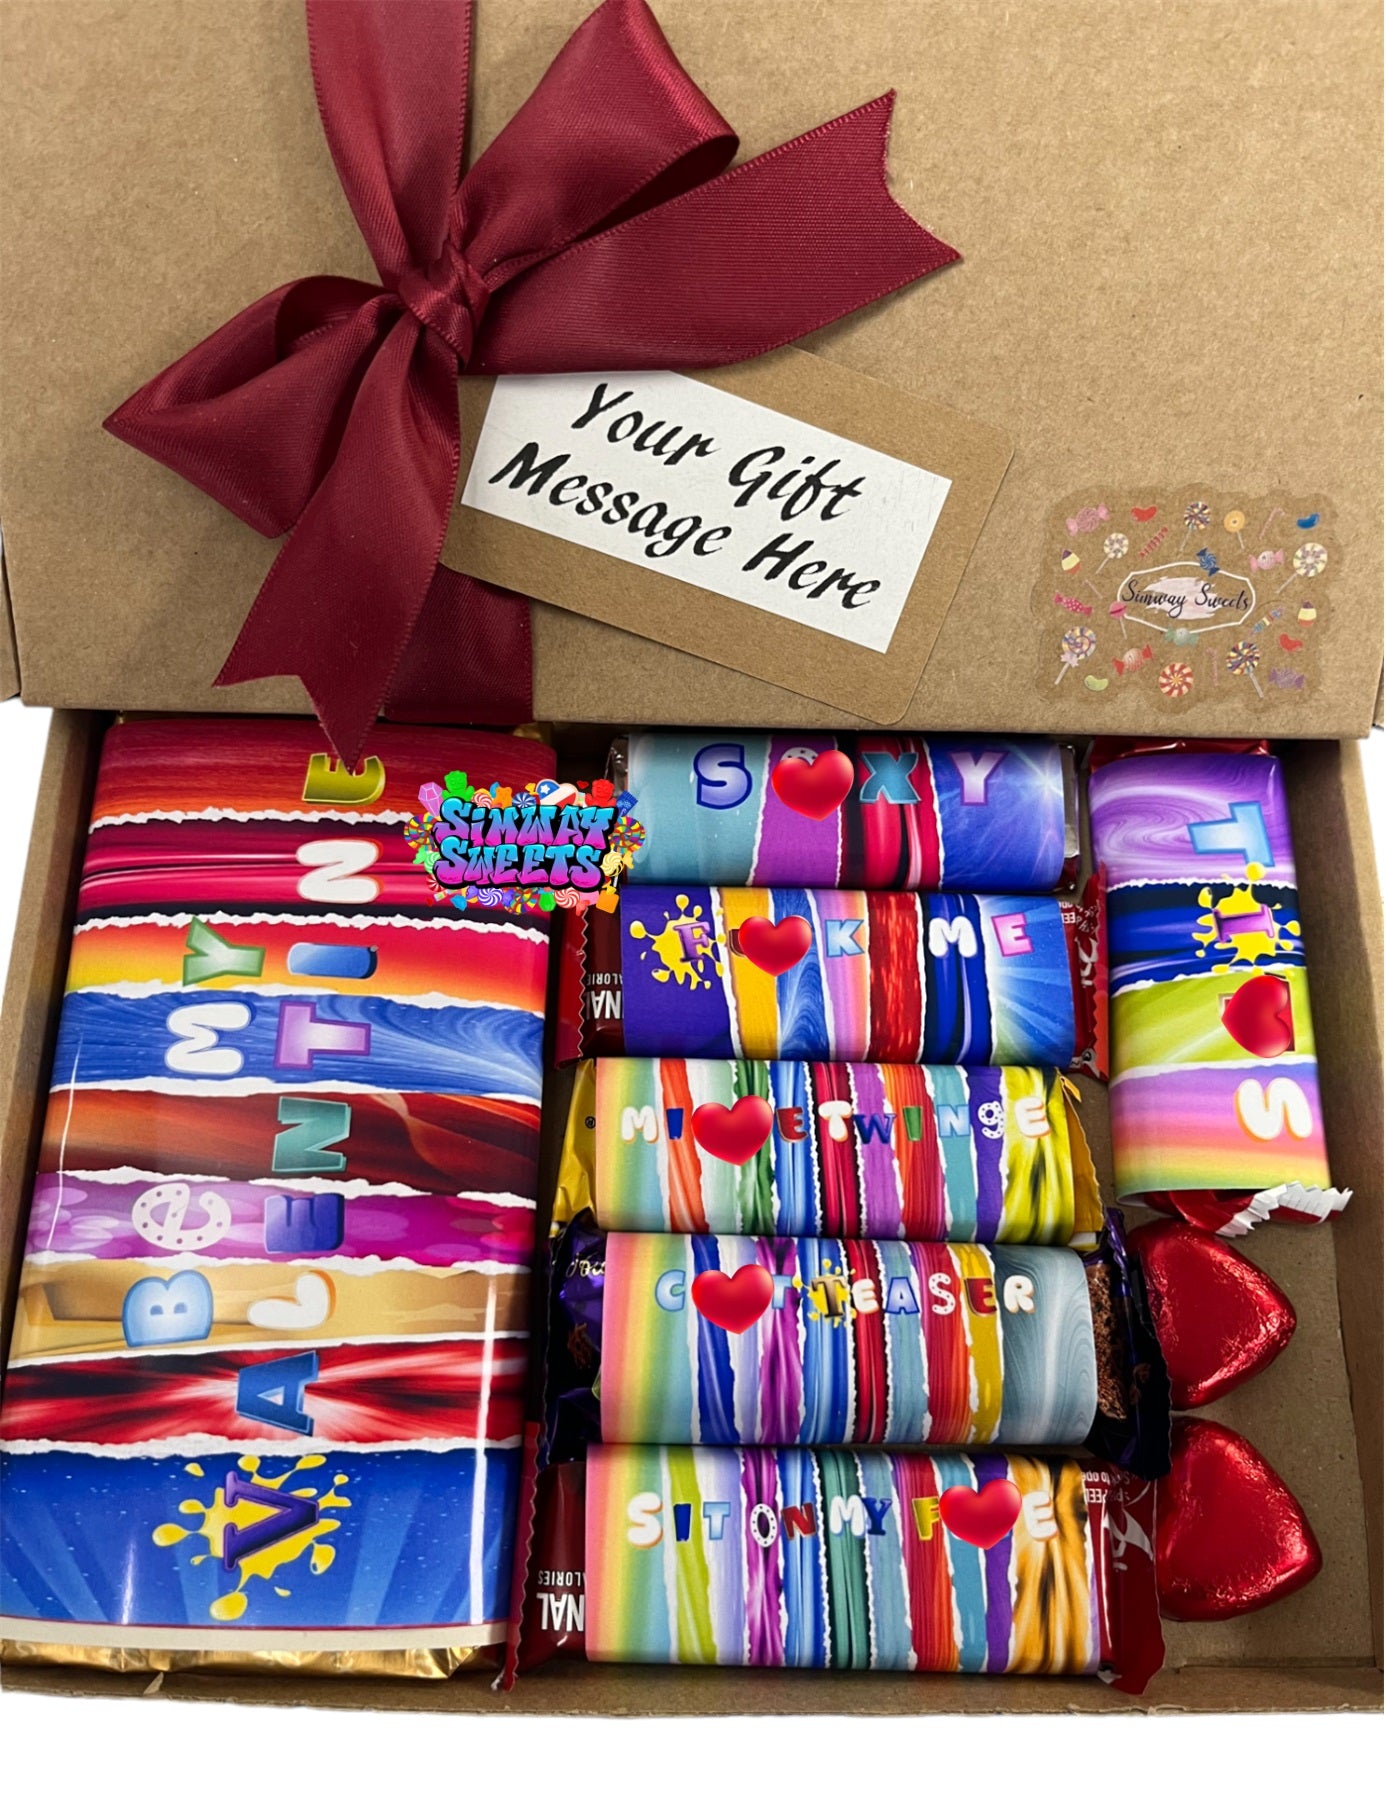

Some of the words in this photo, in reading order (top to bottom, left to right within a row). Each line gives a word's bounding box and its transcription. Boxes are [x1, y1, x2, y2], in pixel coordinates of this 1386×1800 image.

[571, 383, 716, 466] Your
[728, 446, 866, 521] Gift
[488, 442, 732, 558] Message
[741, 532, 881, 610] Here
[1194, 583, 1249, 610] Sweets
[693, 743, 1009, 810] SXY
[676, 917, 868, 965] FK
[928, 913, 1034, 958] ME
[1187, 801, 1313, 1142] TIS
[165, 917, 264, 1075] MY
[222, 752, 386, 1572] VALENTINE
[811, 1274, 1035, 1317] TEASER
[626, 1492, 731, 1548] SIT
[749, 1501, 817, 1548] ON
[830, 1494, 890, 1537] MY
[912, 1491, 1058, 1542] FE
